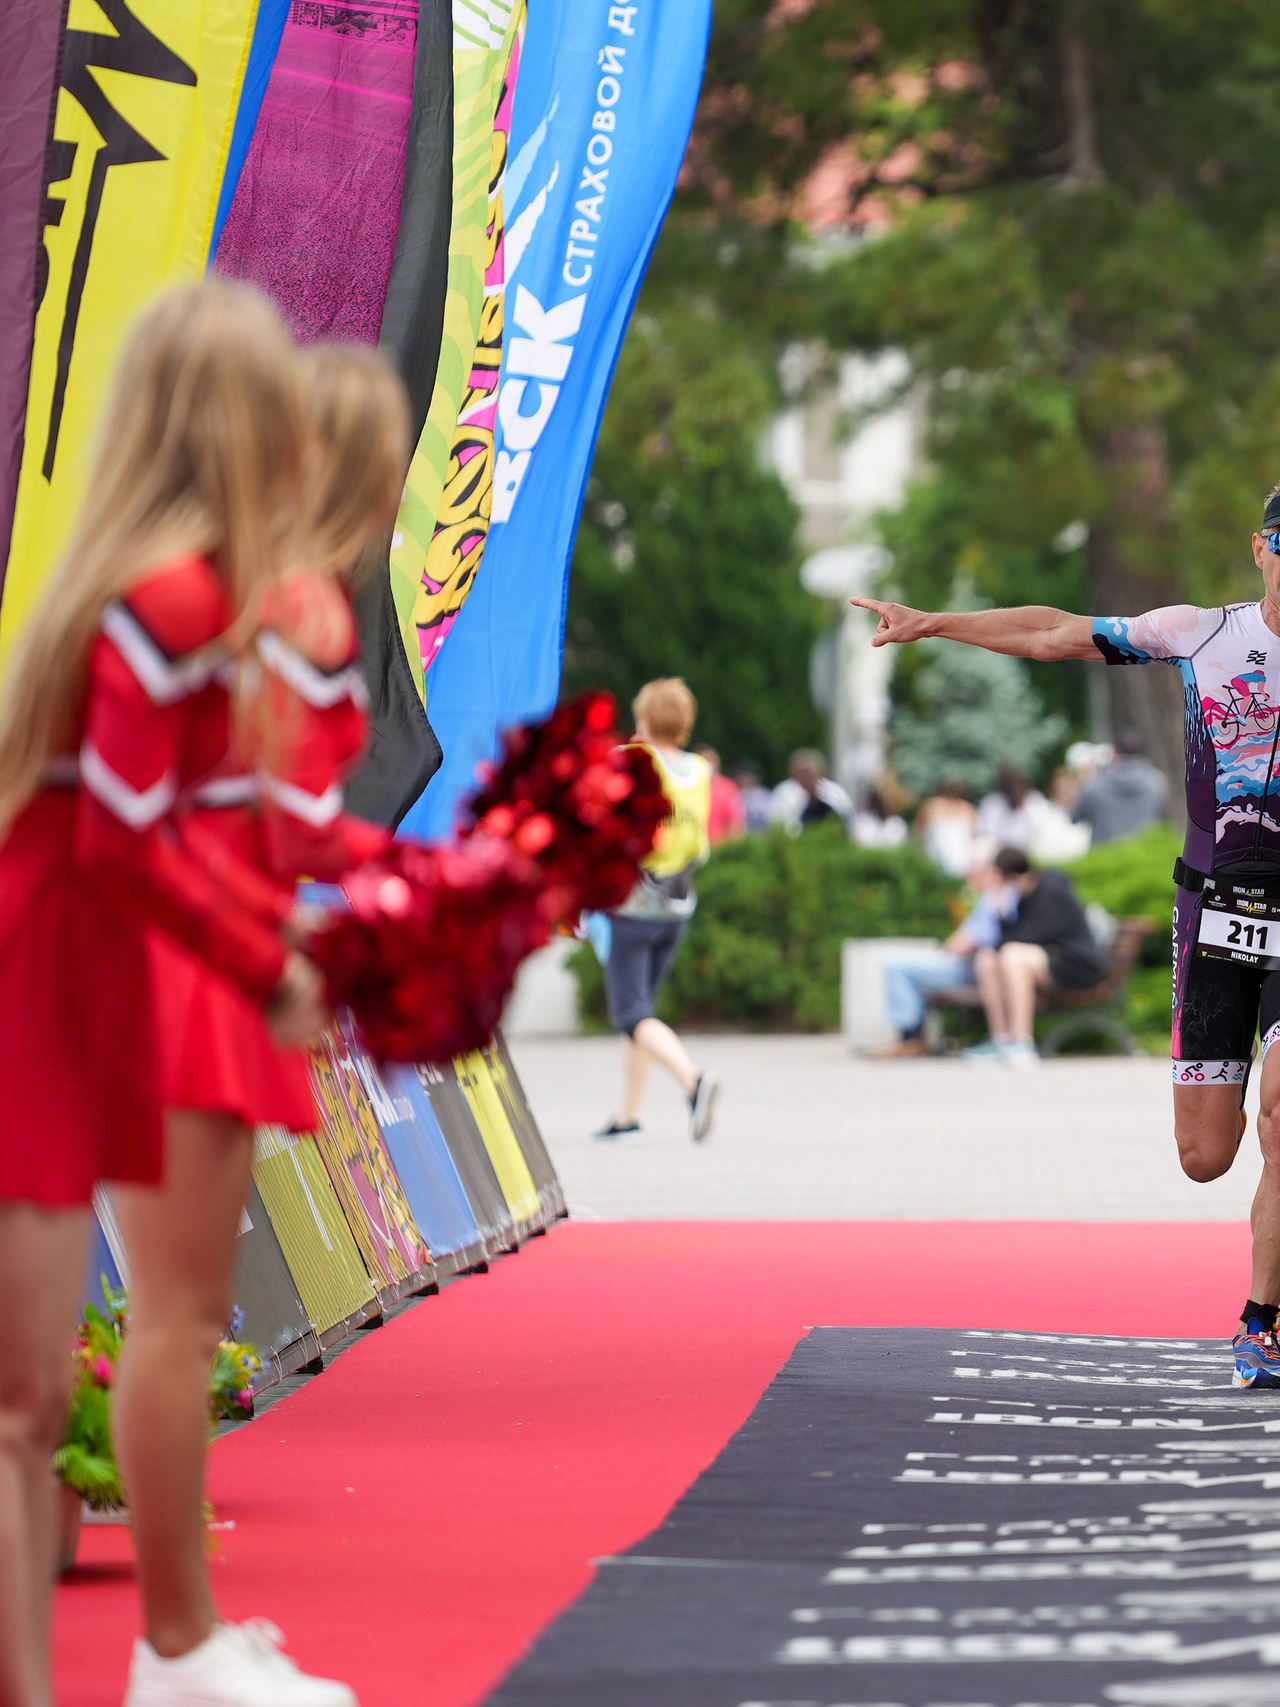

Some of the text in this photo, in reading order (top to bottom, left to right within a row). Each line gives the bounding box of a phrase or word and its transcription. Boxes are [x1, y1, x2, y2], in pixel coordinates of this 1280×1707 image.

[562, 0, 638, 287] СТРАХОВОЙ Д
[490, 282, 588, 523] ВСК
[1232, 885, 1246, 894] IRON
[1236, 899, 1249, 907] IRON
[1253, 902, 1267, 910] STAR
[1226, 920, 1269, 950] 211
[1230, 951, 1259, 963] NIKOLAY
[932, 1412, 1203, 1429] IRON
